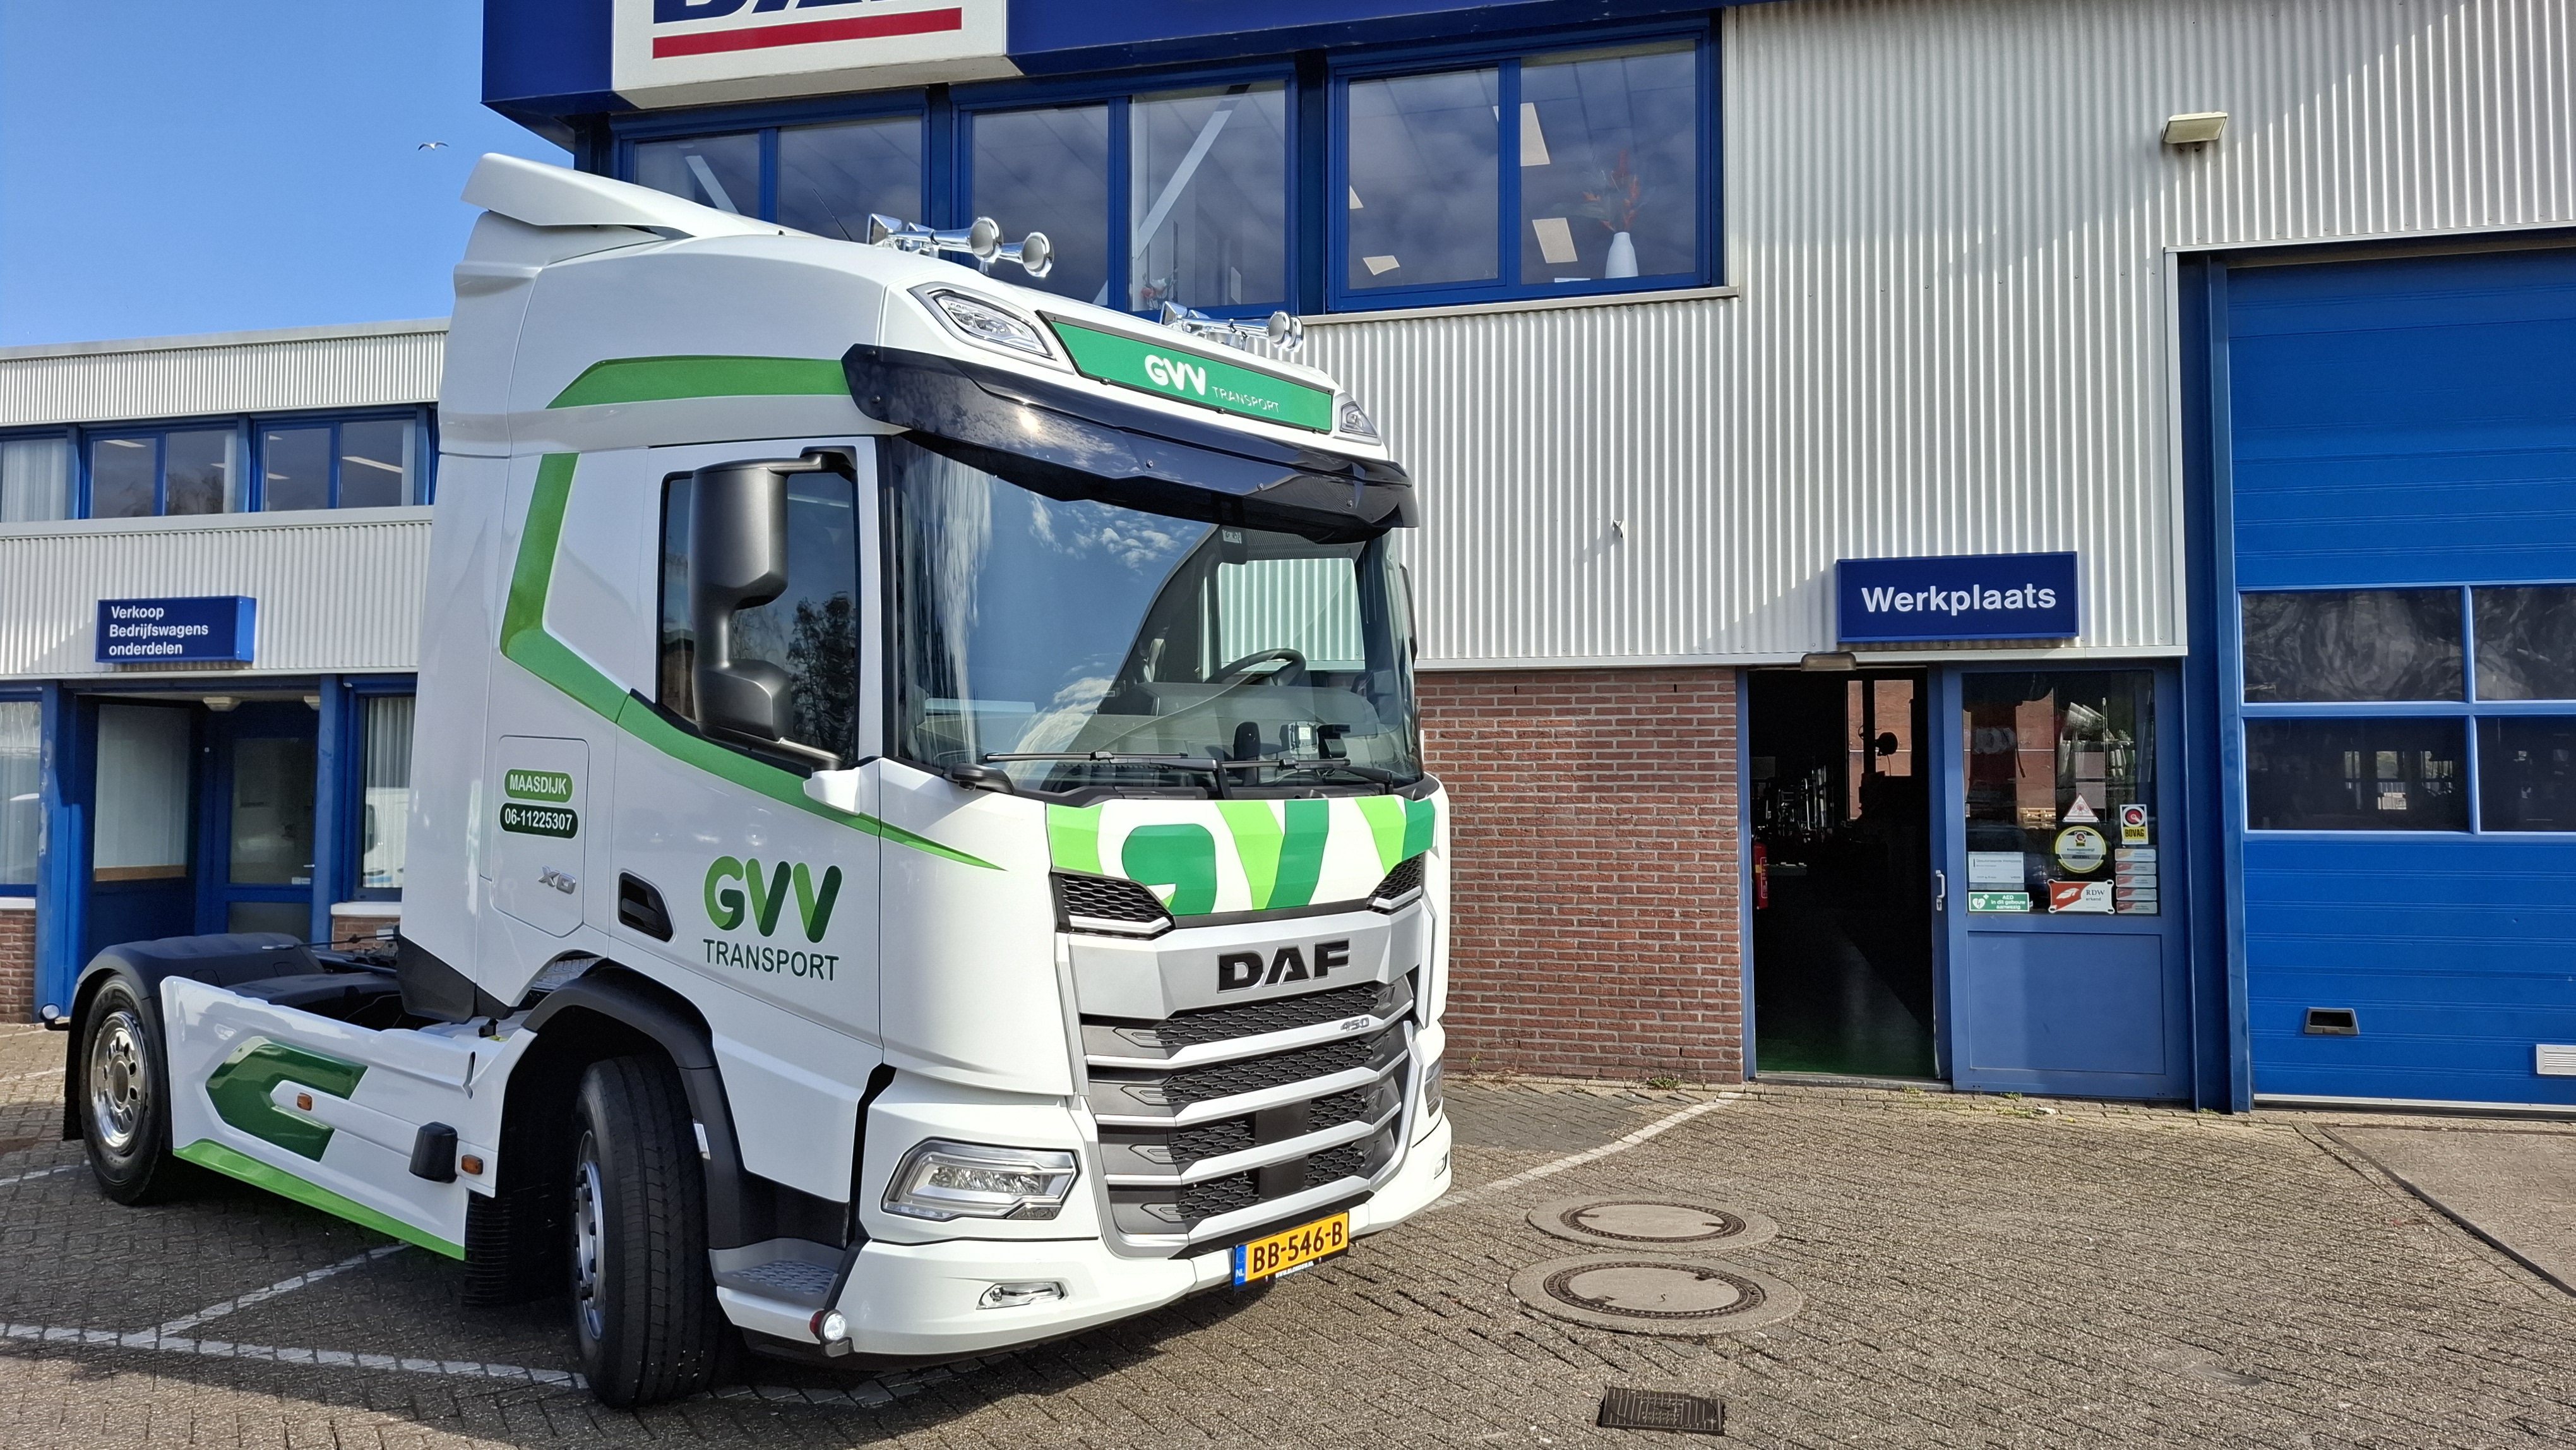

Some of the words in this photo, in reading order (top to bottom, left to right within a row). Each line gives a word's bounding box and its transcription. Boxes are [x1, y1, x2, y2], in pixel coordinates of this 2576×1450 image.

[1144, 354, 1207, 396] GVV
[1212, 386, 1280, 414] TRANSPORT
[1861, 583, 2056, 616] Werkplaats
[111, 606, 164, 620] Verkoop
[109, 623, 209, 639] Bedrijfswagens
[109, 642, 182, 656] onderdelen
[509, 774, 567, 795] MAASDIJK
[504, 808, 573, 831] 06-11225307
[2125, 829, 2144, 837] BOVAG
[703, 854, 843, 944] GVV
[703, 938, 840, 981] TRANSPORT
[1217, 938, 1351, 993] DAF
[1340, 1017, 1369, 1032] 450
[1253, 1221, 1343, 1274] BB-546-B
[1235, 1268, 1244, 1278] NL
